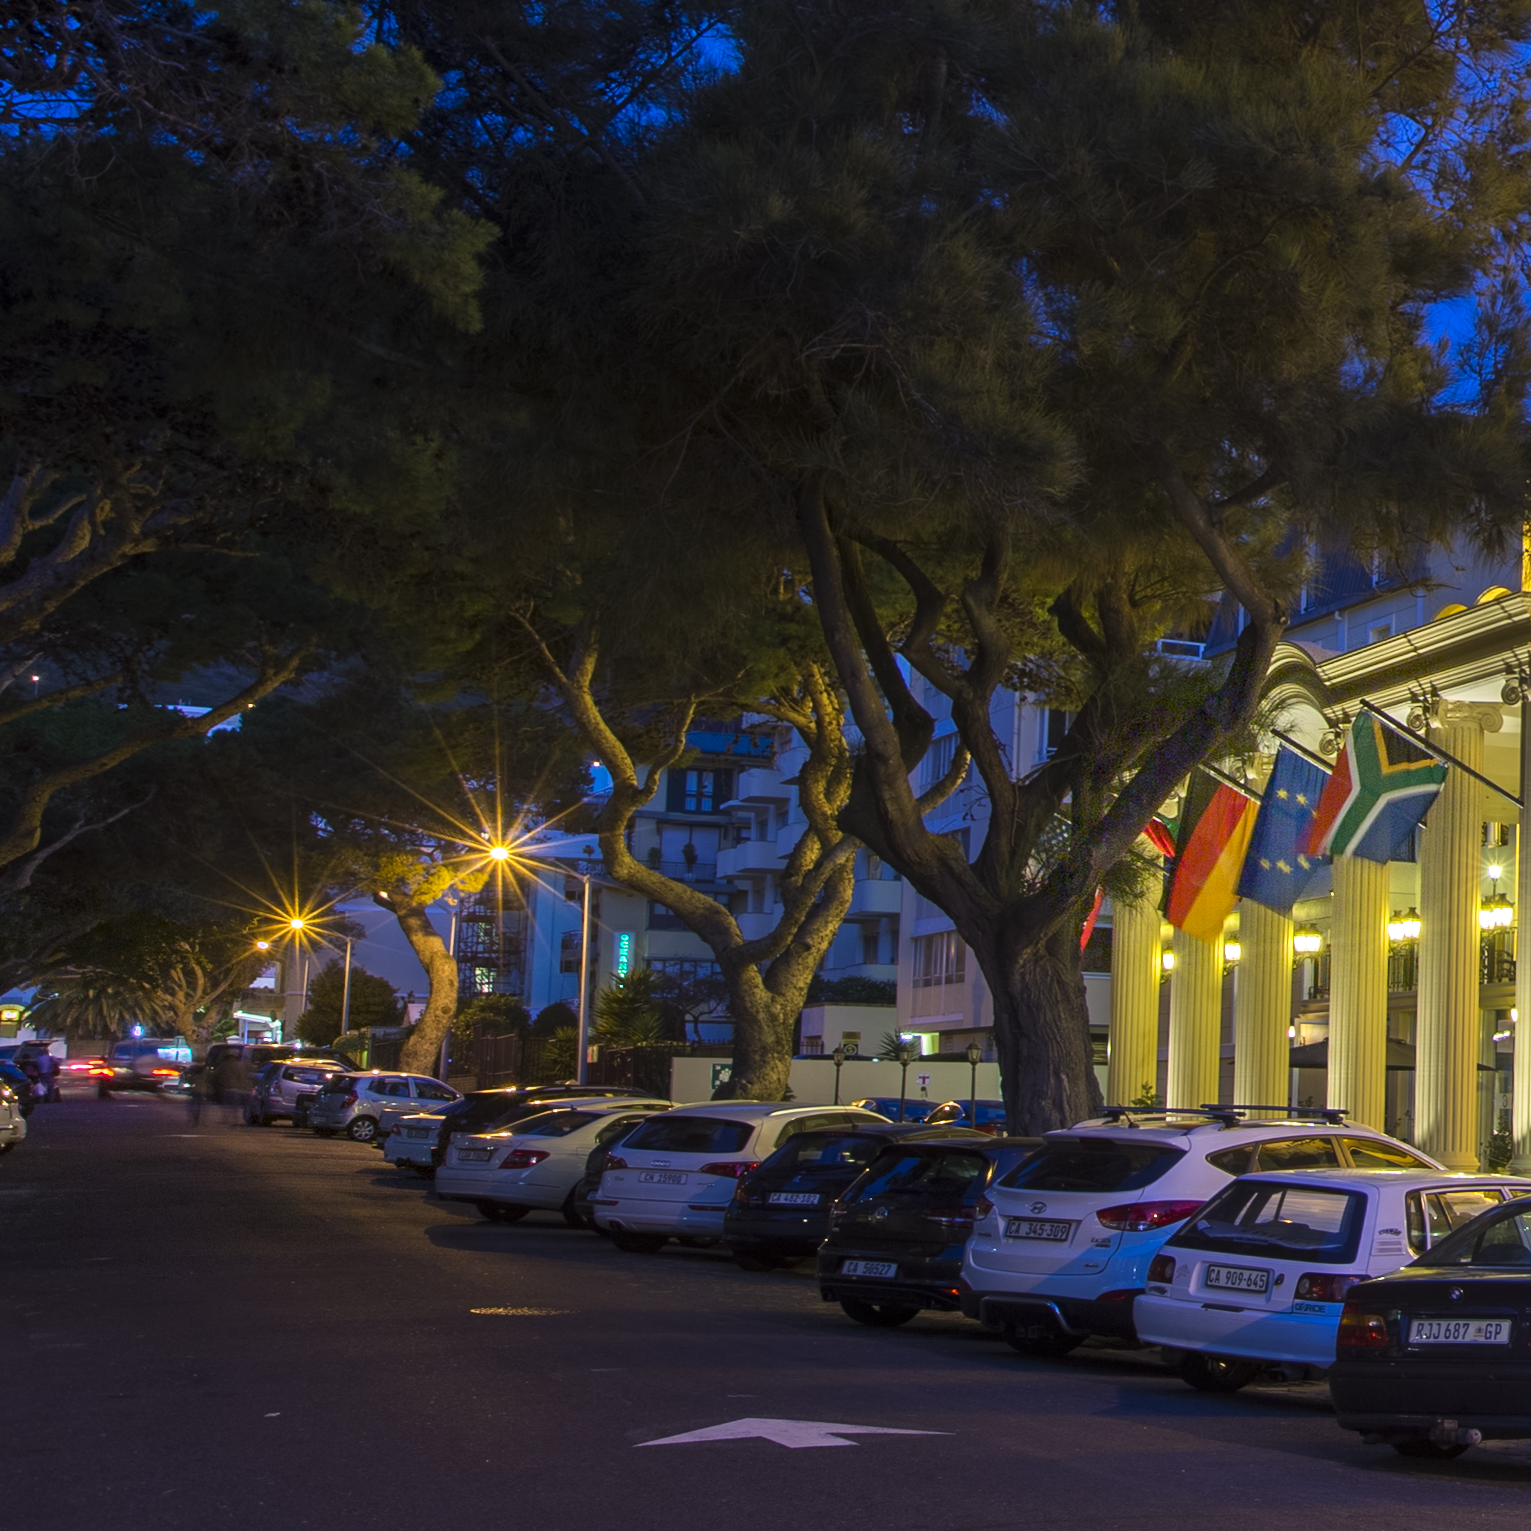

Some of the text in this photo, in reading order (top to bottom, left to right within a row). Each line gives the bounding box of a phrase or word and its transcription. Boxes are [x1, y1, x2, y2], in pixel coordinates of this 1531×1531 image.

[1008, 1222, 1067, 1238] CA 345-309
[847, 1262, 859, 1273] CA
[1208, 1268, 1266, 1289] CA 909-645
[1416, 1323, 1502, 1340] RJJ 687 GP
